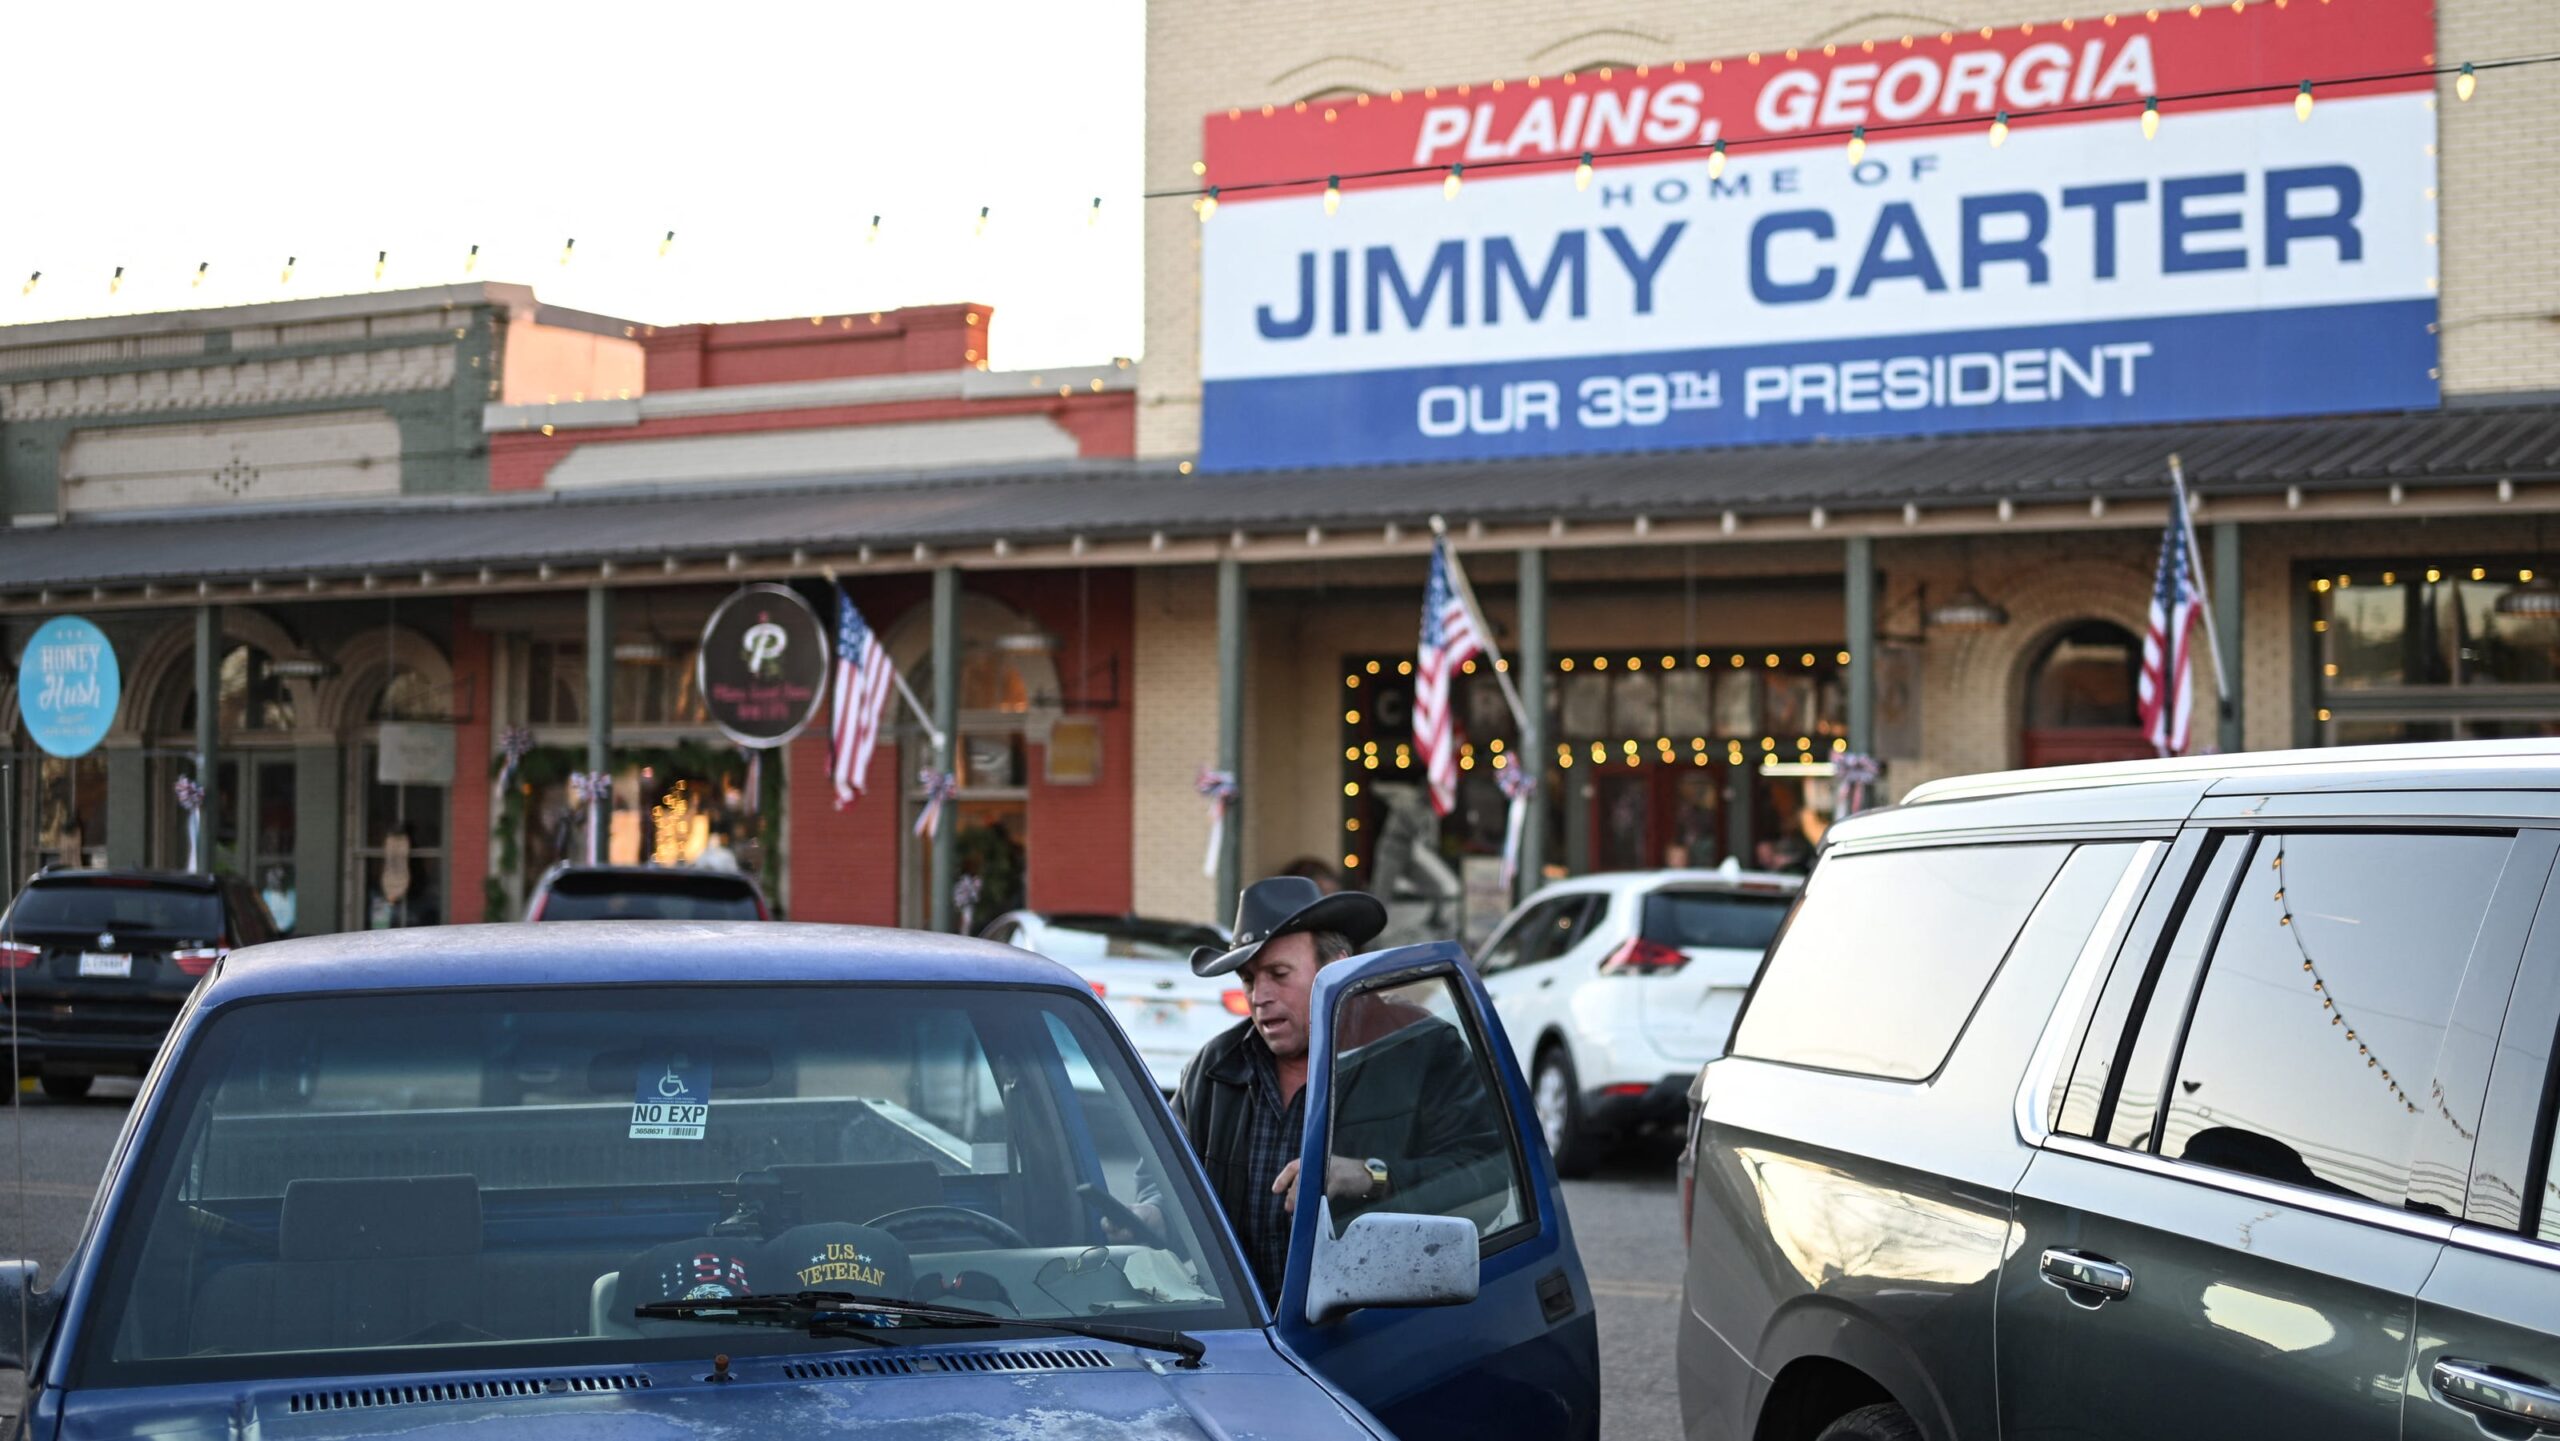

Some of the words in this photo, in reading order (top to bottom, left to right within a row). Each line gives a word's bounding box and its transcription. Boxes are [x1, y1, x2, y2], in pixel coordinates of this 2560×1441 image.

[1413, 82, 1722, 165] PLAINS,
[1755, 34, 2156, 132] GEORGIA
[1601, 166, 1801, 209] HOME
[1851, 154, 1940, 187] OF
[1256, 220, 1689, 341] JIMMY
[1749, 163, 2364, 305] CARTER
[1418, 380, 1560, 438] OUR
[1577, 370, 1721, 429] 39TH
[1744, 341, 2154, 419] PRESIDENT
[41, 643, 101, 672] HONEY
[38, 674, 101, 712] Hush
[634, 1105, 662, 1122] NO
[668, 1106, 706, 1123] EXP
[826, 1243, 858, 1261] U.S.
[796, 1261, 885, 1288] VETERAN
